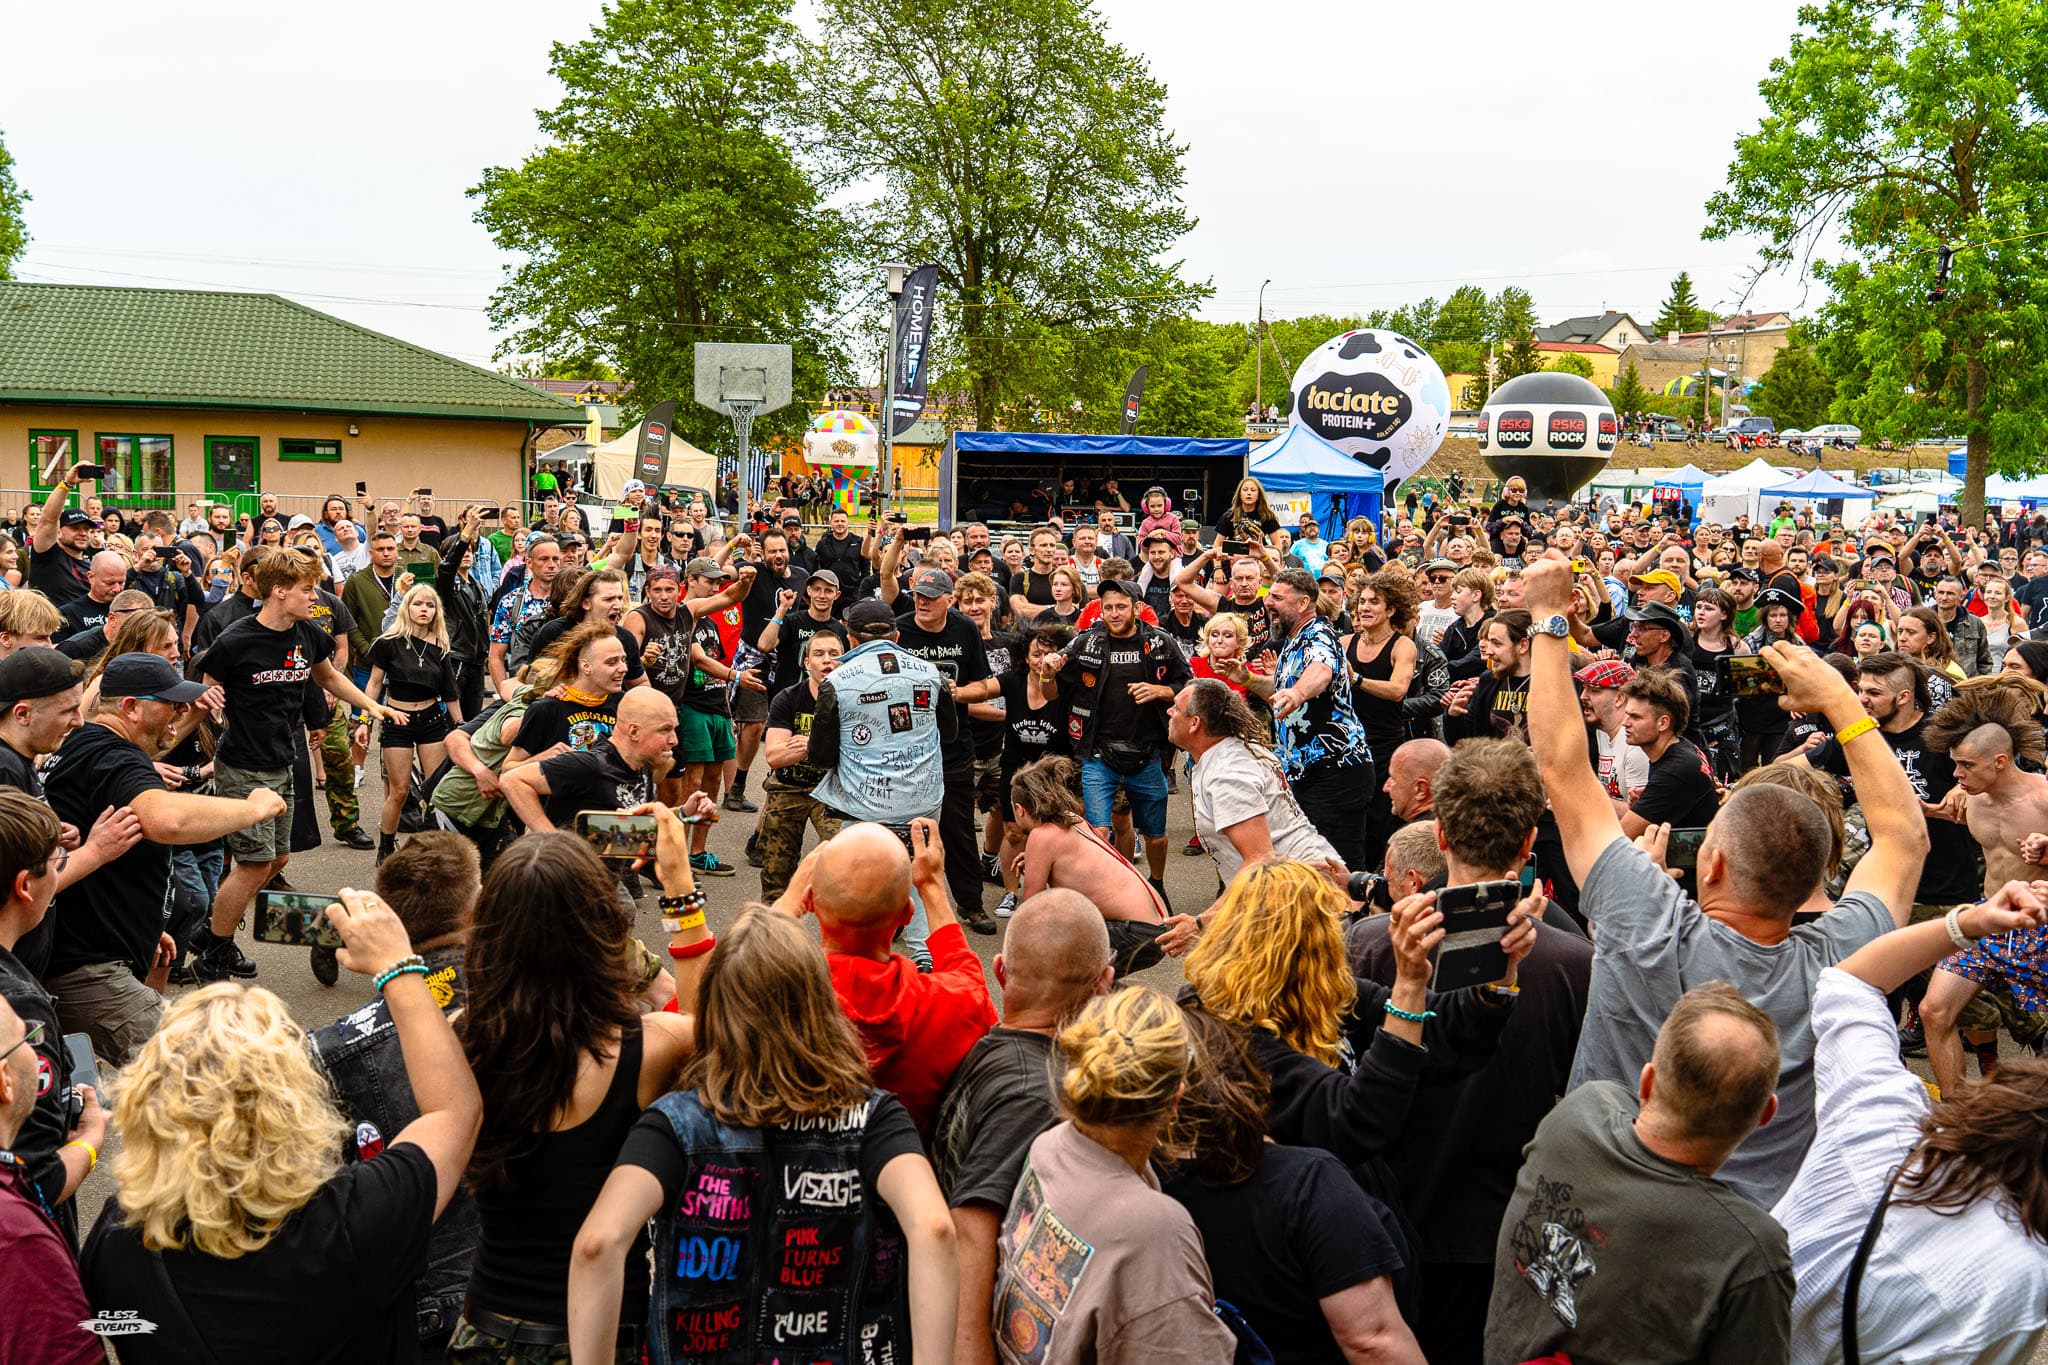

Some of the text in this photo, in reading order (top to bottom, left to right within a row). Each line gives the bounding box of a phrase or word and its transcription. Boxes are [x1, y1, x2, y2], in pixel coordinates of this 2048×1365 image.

[1308, 385, 1399, 415] łaciate
[1322, 413, 1376, 430] PROTEIN+
[1498, 431, 1531, 442] ROCK
[1550, 432, 1584, 442] ROCK
[865, 774, 892, 786] LIMP
[858, 782, 893, 800] BIZKIT
[698, 1173, 731, 1196] THE
[784, 1164, 862, 1206] VISAGE
[785, 1228, 820, 1248] PINK
[676, 1236, 741, 1282] IDOL
[784, 1246, 841, 1268] TURNS
[780, 1266, 824, 1286] BLUE
[676, 1304, 742, 1334] KILLING
[774, 1310, 828, 1343] CURE
[682, 1333, 730, 1353] JOKE
